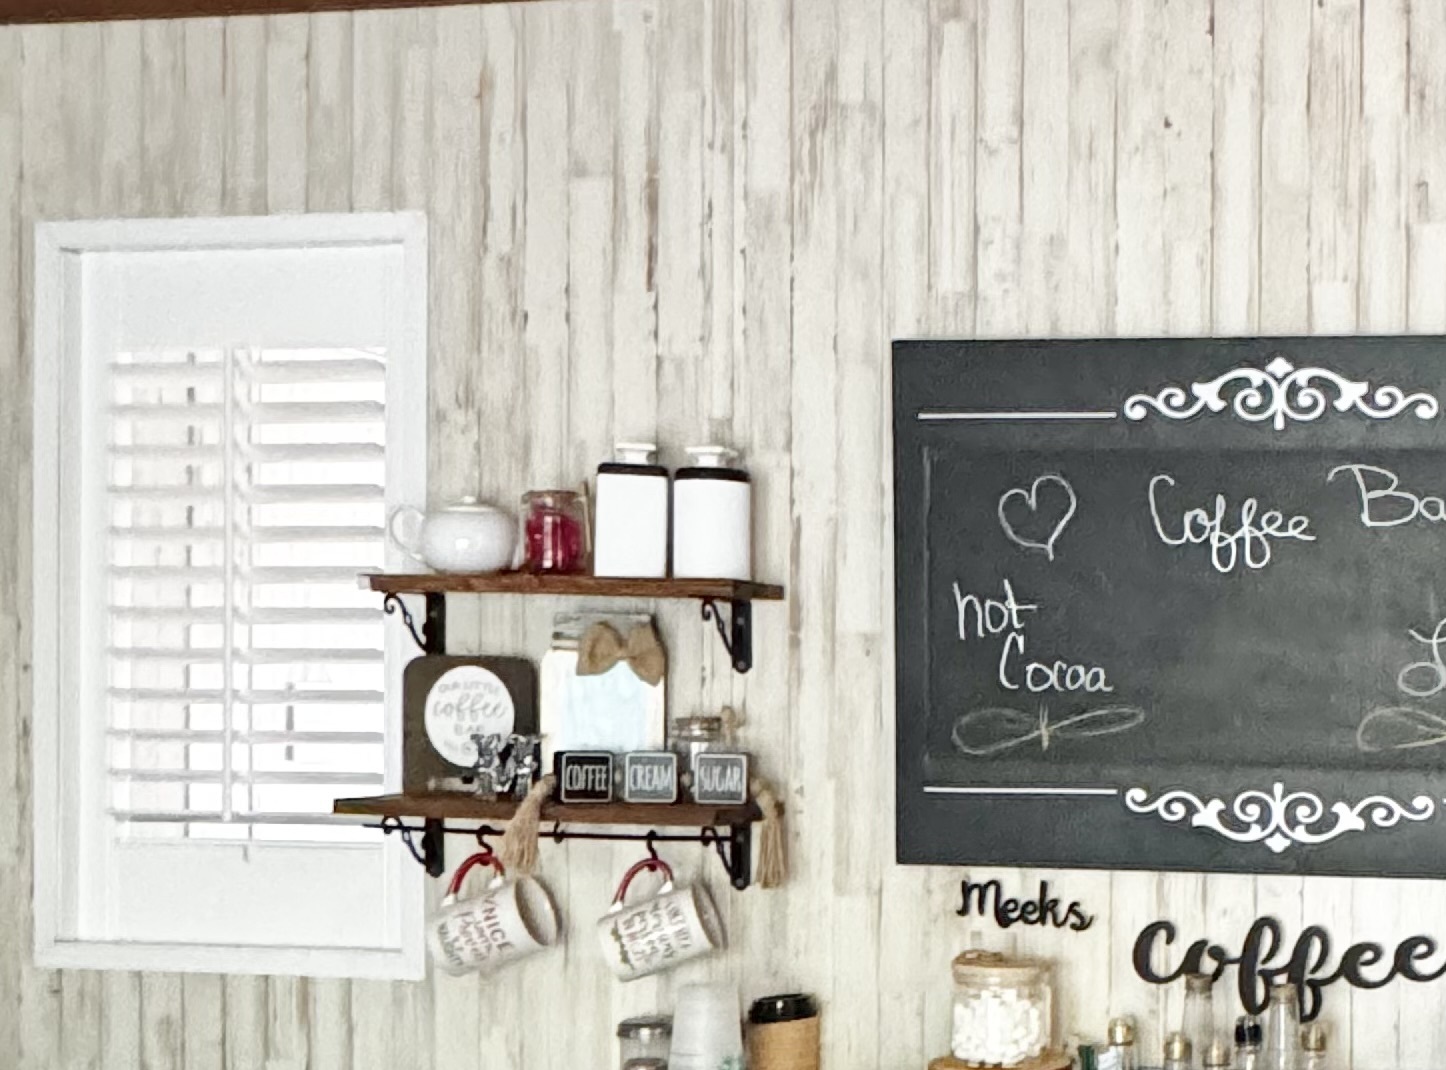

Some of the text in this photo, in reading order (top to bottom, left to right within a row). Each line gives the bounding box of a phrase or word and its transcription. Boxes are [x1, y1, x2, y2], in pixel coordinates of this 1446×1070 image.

[566, 764, 608, 791] COFFEE
[630, 764, 673, 792] CREAM
[700, 765, 741, 792] SUGAR
[957, 880, 1095, 931] Meeks
